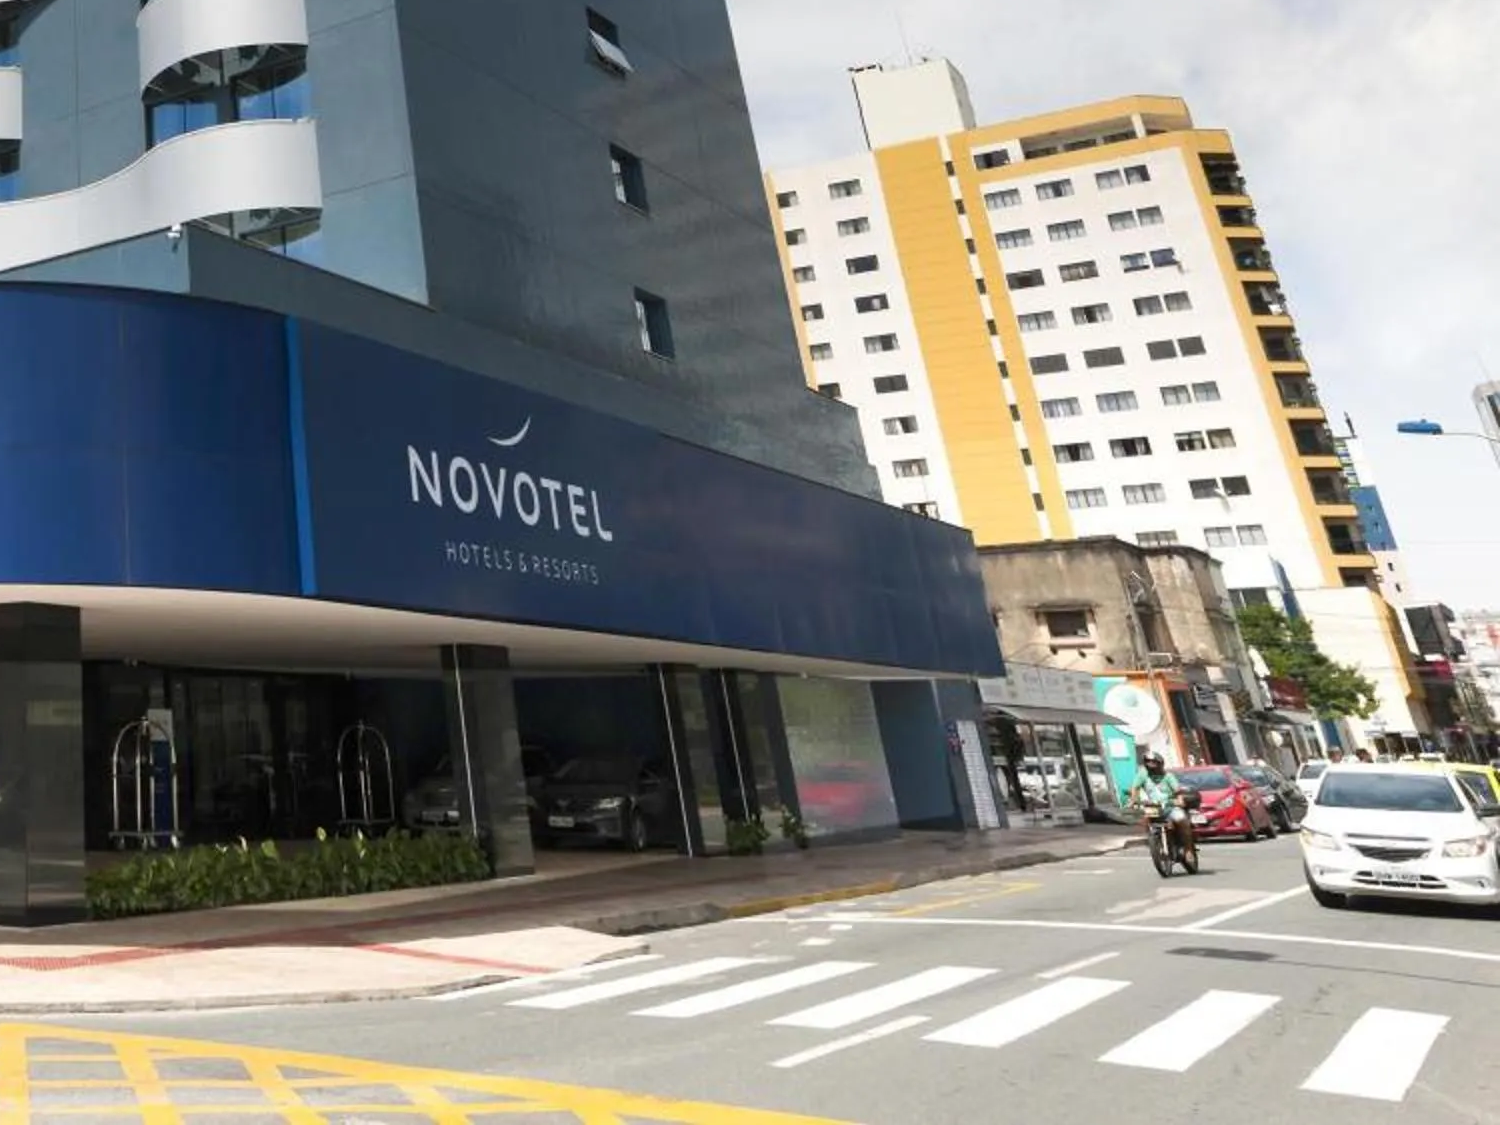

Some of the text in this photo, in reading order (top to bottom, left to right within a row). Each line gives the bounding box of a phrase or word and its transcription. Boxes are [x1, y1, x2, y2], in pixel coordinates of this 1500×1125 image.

[407, 444, 613, 542] NOVOTEL
[445, 540, 599, 585] HOTELS & RESORTS
